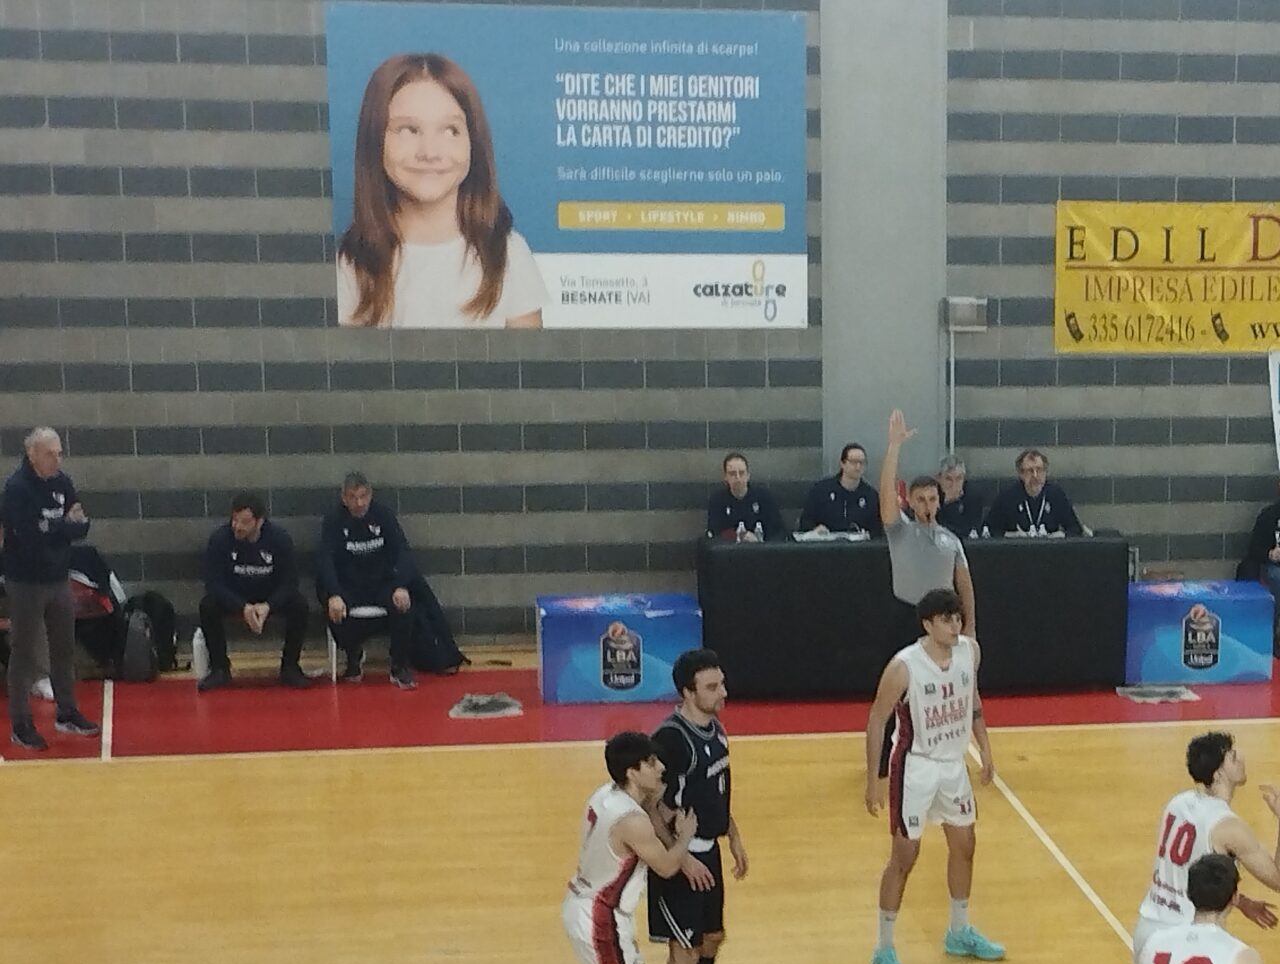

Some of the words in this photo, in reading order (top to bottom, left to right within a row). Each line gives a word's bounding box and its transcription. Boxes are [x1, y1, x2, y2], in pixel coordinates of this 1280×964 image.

[555, 38, 579, 51] Una
[584, 39, 647, 54] collezione
[651, 40, 694, 55] infinita
[698, 40, 709, 55] di
[604, 73, 636, 97] CHE
[640, 74, 646, 97] I
[650, 74, 684, 98] MIEI
[688, 75, 760, 99] GENITORI
[556, 98, 644, 122] VORRANNO
[648, 99, 737, 124] PRESTARMI
[556, 123, 577, 147] LA
[581, 124, 632, 148] CARTA
[636, 125, 652, 148] DI
[708, 167, 733, 182] solo
[736, 169, 752, 182] un
[561, 290, 623, 305] BESNATE
[1084, 274, 1194, 303] IMPRESA
[1202, 274, 1280, 303] EDILE
[1088, 312, 1119, 342] 335
[1124, 313, 1195, 342] 6172416
[1158, 812, 1197, 866] 10
